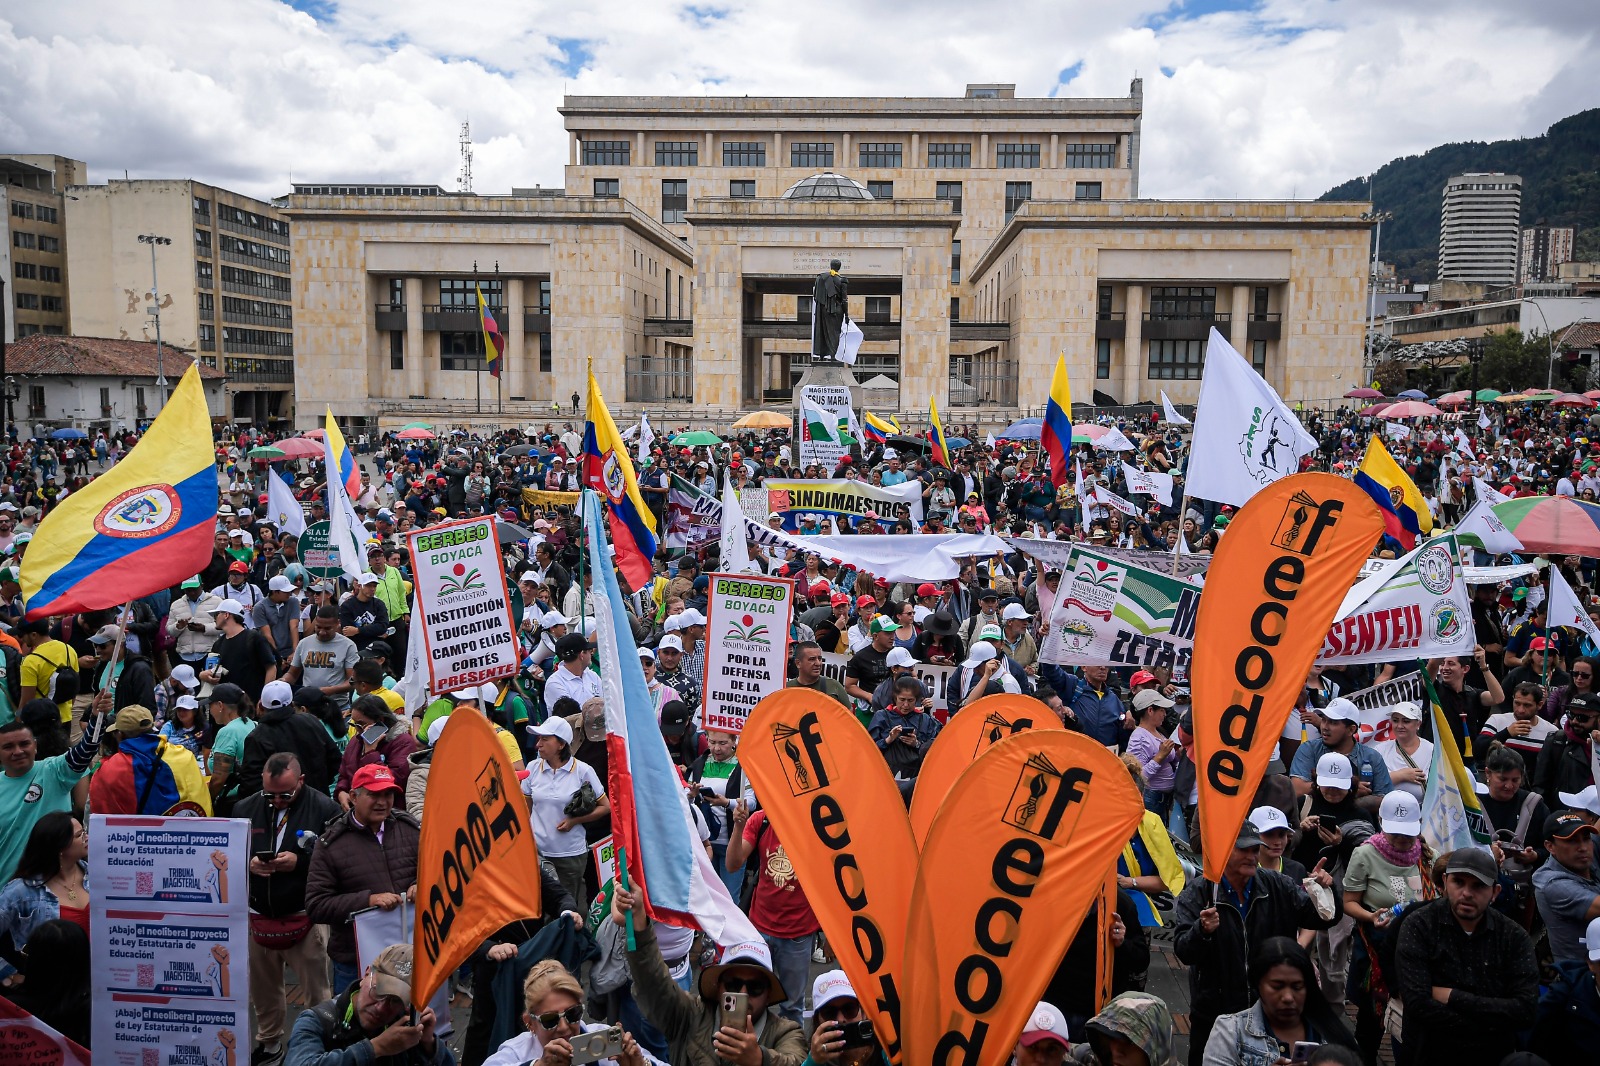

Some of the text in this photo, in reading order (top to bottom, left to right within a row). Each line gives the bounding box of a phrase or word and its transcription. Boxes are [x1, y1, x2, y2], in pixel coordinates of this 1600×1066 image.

[806, 395, 849, 406] ESUS MARIA
[416, 523, 489, 553] BERBEO
[431, 542, 483, 566] BOYACÁ
[437, 588, 488, 607] SINDIMAESTROS
[716, 579, 786, 602] BERBEO
[426, 598, 505, 626] INSTITUCIÓN
[724, 600, 776, 615] BOYACÁ
[435, 616, 503, 642] EDUCATIVA
[1315, 604, 1422, 660] SENTE!!
[432, 631, 512, 661] CAMPO ELÍAS
[722, 640, 772, 653] SINDIMAESTROS
[303, 650, 336, 668] AMC
[451, 651, 500, 673] CORTÉS
[727, 653, 767, 667] POR LA
[437, 663, 514, 690] PRESENTE
[721, 666, 771, 681] DEFENSA
[730, 680, 761, 693] DE LA
[712, 690, 761, 706] EDUCACI
[719, 704, 751, 718] PÚBLI
[708, 714, 746, 730] PRES
[107, 833, 228, 845] ¡Abajo el neoliberal proyecto
[107, 845, 197, 856] de Ley Estatutaria de
[107, 857, 154, 867] Educación!
[168, 867, 195, 878] TRIBUNA
[162, 877, 202, 890] MAGISTERIAL
[109, 925, 228, 939] ¡Abajo el neoliberal proyecto
[109, 938, 196, 950] de Ley Estatutaria de
[109, 949, 155, 960] Educación!
[168, 961, 195, 971] TRIBUNA
[163, 970, 203, 984] MAGISTERIAL
[115, 1008, 235, 1023] ¡Abajo el neoliberal proyecto
[115, 1021, 203, 1033] de Ley Estatutaria de
[115, 1032, 160, 1043] Educación!
[175, 1044, 201, 1055] TRIBUNA
[168, 1053, 208, 1066] MAGISTERIAL
